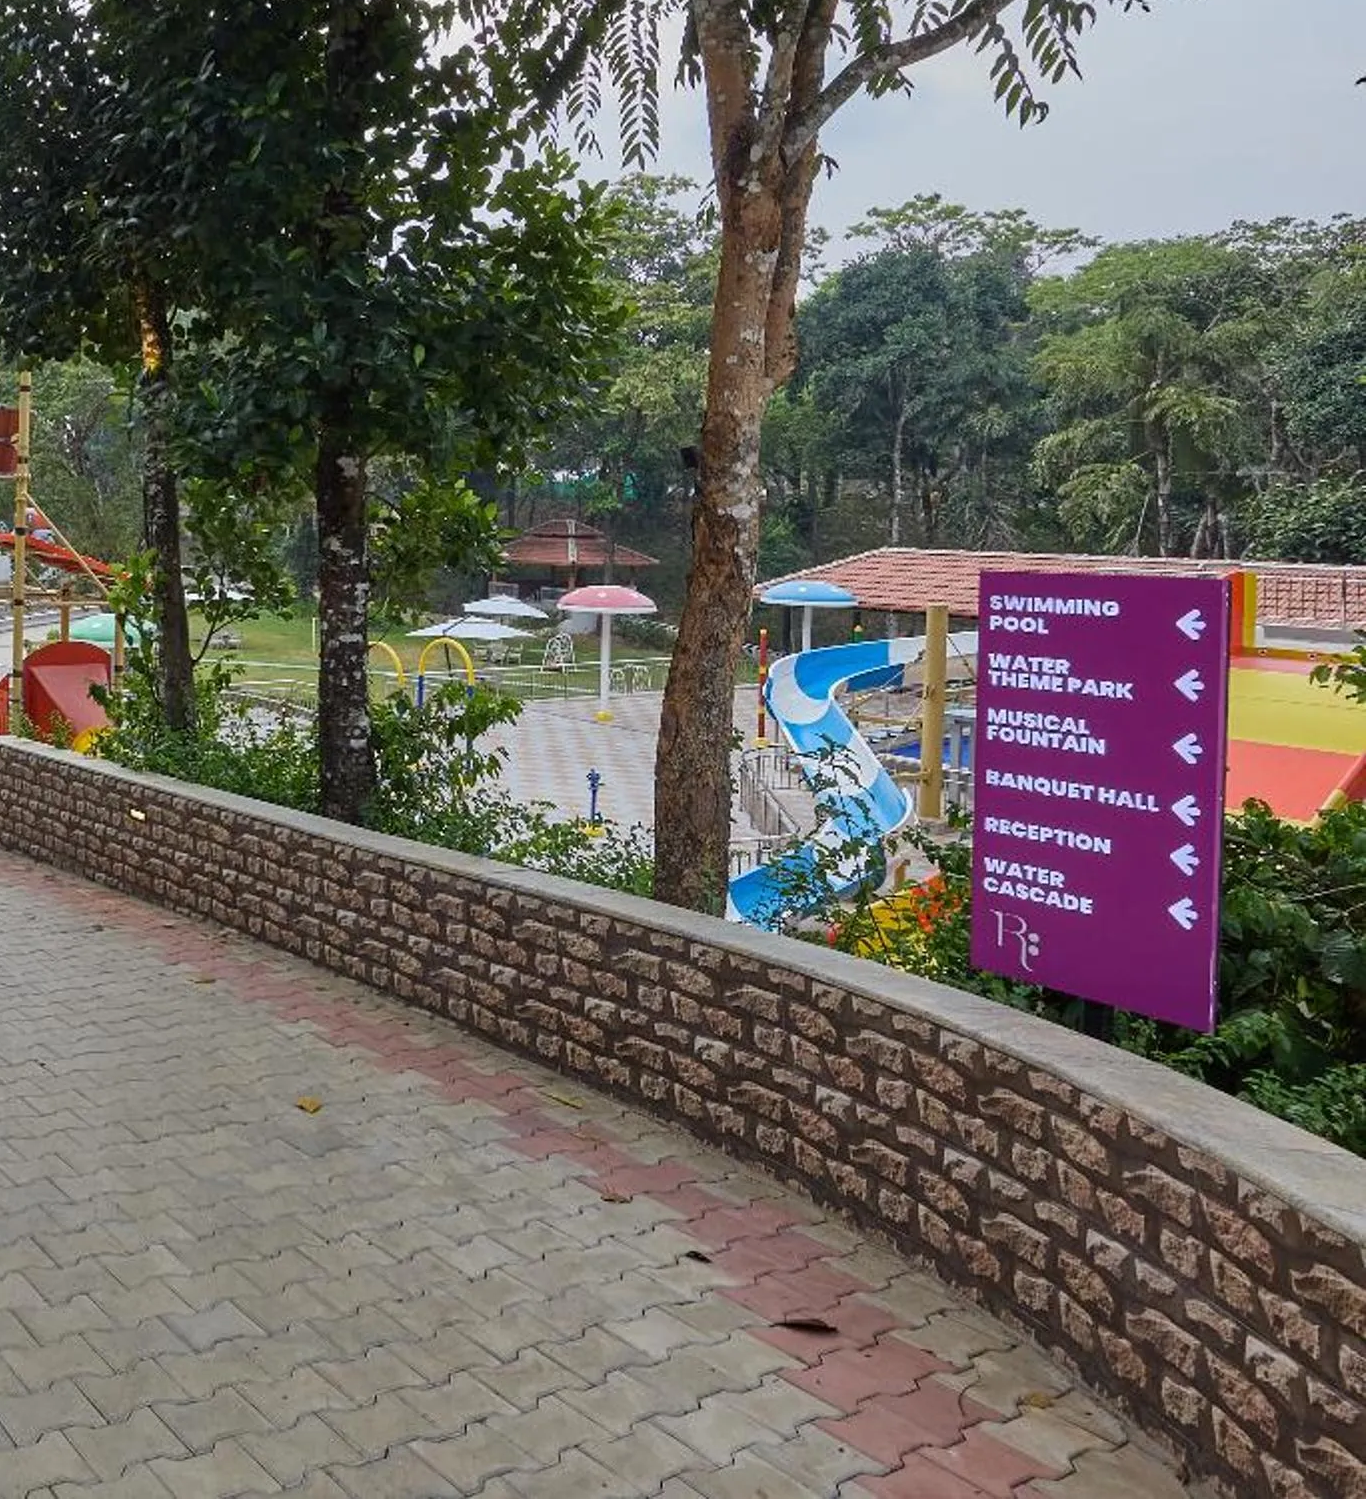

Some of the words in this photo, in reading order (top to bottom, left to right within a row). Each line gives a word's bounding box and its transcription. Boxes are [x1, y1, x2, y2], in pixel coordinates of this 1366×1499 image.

[990, 595, 1119, 617] SWIMMING
[990, 615, 1049, 635] POOL
[989, 653, 1069, 674] WATER
[989, 671, 1063, 692] THEME
[1068, 678, 1133, 700] PARK
[987, 708, 1090, 735] MUSICAL
[987, 726, 1105, 755] FOUNTAIN
[986, 770, 1094, 800] BANQUET
[1098, 787, 1159, 812] HALL
[984, 817, 1111, 854] RECEPTION
[984, 858, 1064, 888] WATER
[983, 878, 1093, 914] CASCADE
